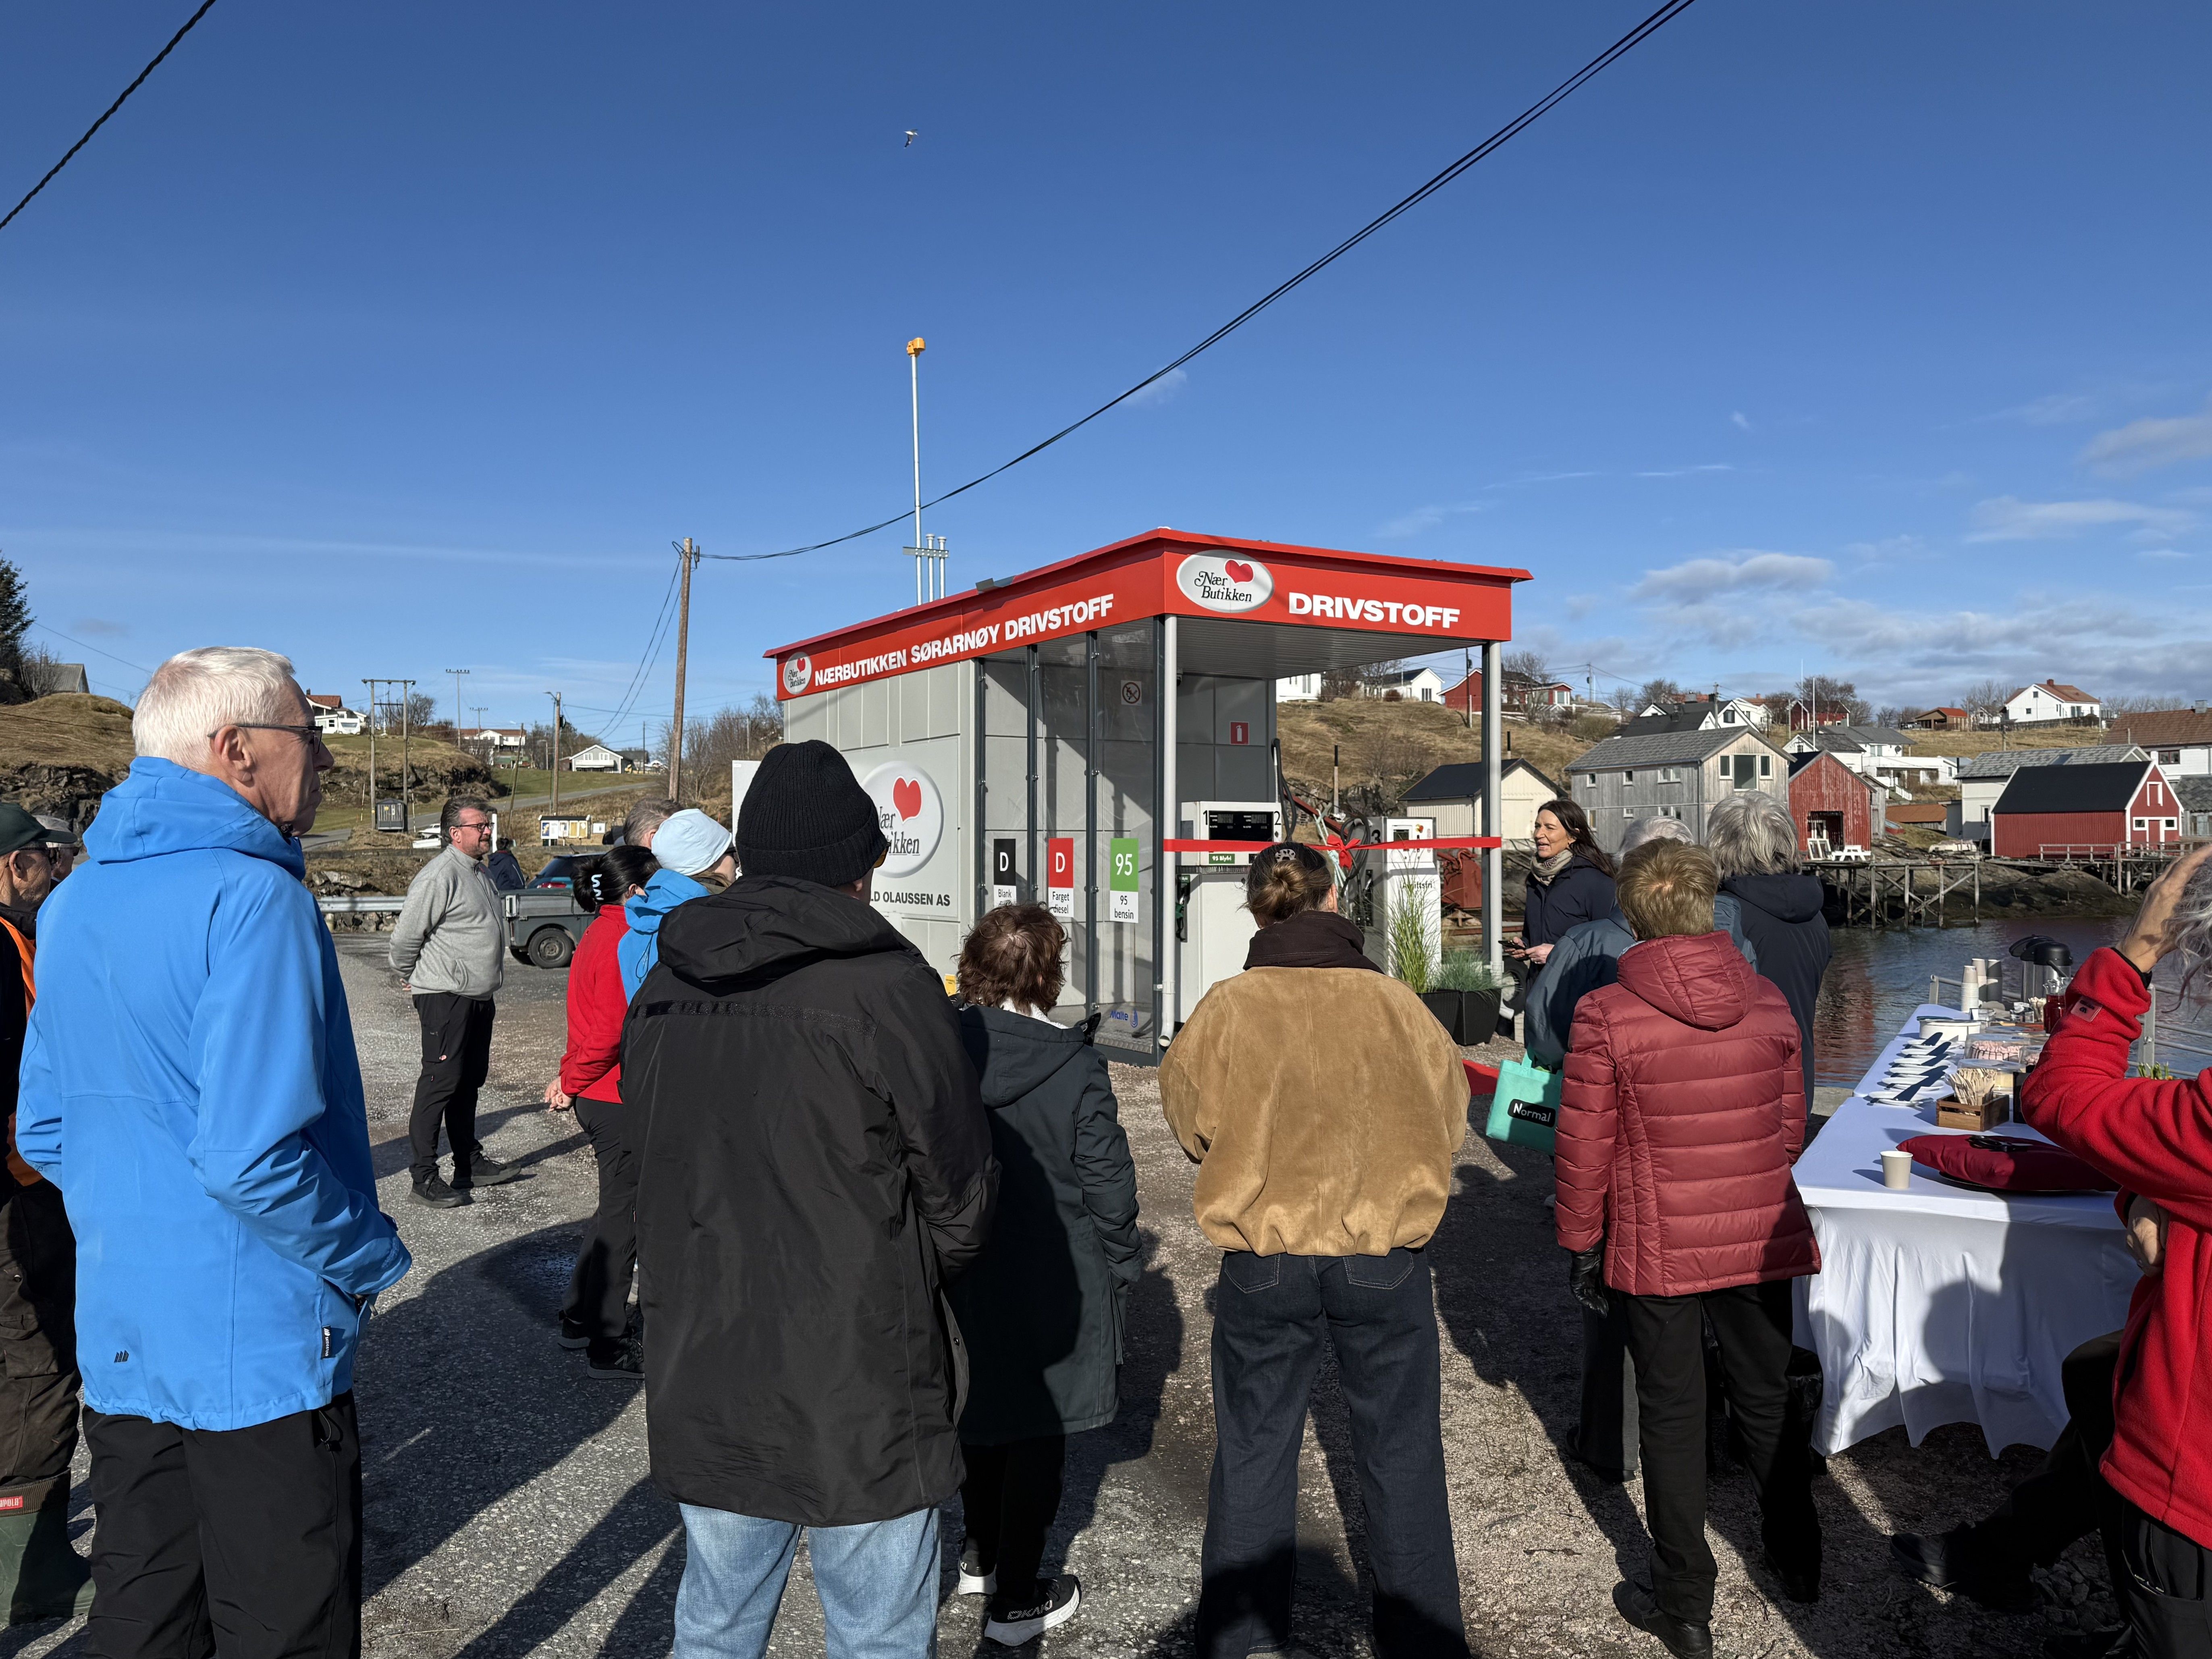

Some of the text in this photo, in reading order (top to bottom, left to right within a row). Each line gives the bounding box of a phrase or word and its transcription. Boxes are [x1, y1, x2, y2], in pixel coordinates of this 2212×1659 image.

[1194, 571, 1228, 587] Nær
[1201, 584, 1252, 602] Butikken
[1289, 592, 1460, 629] DRIVSTOFF
[815, 594, 1114, 686] NÆRBUTIKKEN SØRARNØY DRIVSTOFF
[879, 806, 895, 829] ær
[1203, 810, 1208, 825] 1
[1274, 811, 1282, 825] 2
[1371, 829, 1381, 843] 3
[1000, 852, 1009, 872] D
[1055, 852, 1065, 873] D
[1115, 853, 1133, 876] 95
[883, 891, 933, 905] OLAUSSEN
[936, 894, 950, 906] AS
[998, 889, 1011, 898] Blank
[1053, 892, 1070, 902] Farget
[1120, 896, 1128, 905] 95
[1053, 903, 1069, 914] diesel
[1115, 908, 1134, 920] bensin
[1513, 1103, 1552, 1122] Normal
